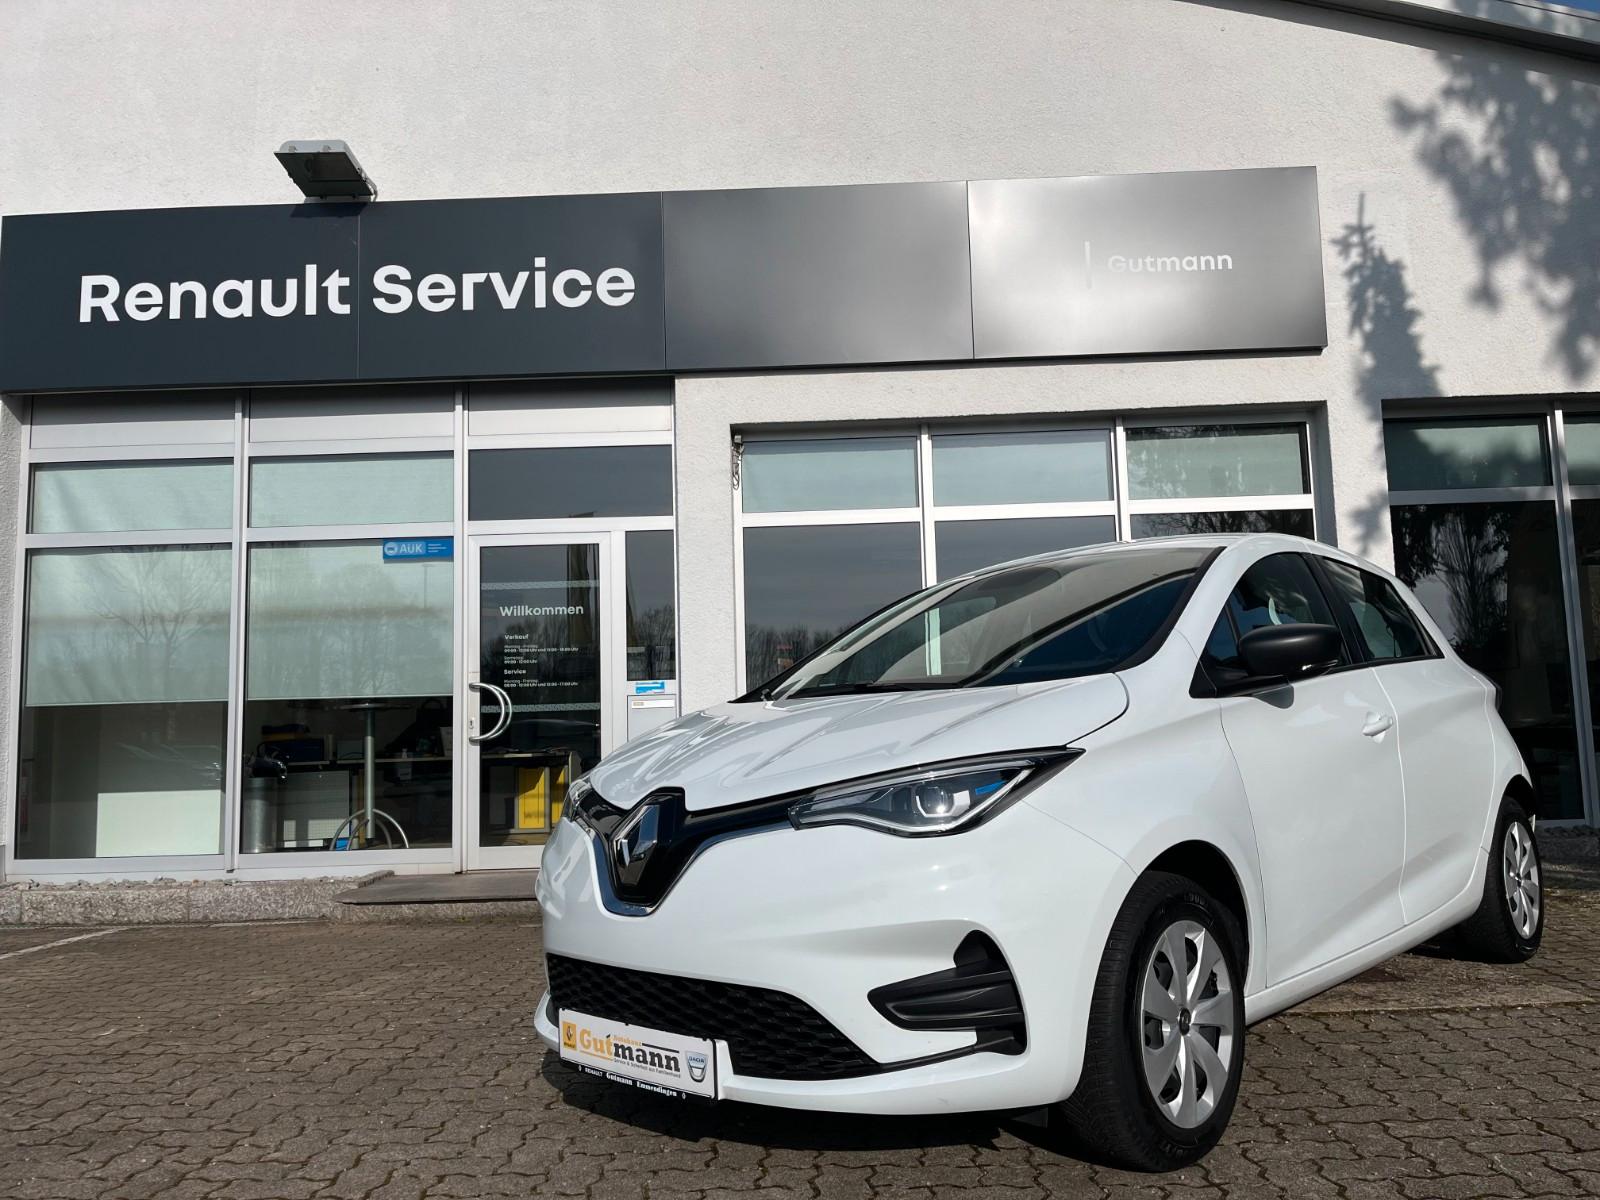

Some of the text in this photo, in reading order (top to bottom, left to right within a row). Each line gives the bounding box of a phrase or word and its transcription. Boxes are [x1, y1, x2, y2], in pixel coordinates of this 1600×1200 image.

[1107, 253, 1233, 273] Gutmann
[79, 257, 635, 323] Renault Service
[499, 605, 584, 617] Willkommen
[579, 1028, 681, 1073] Gutmann
